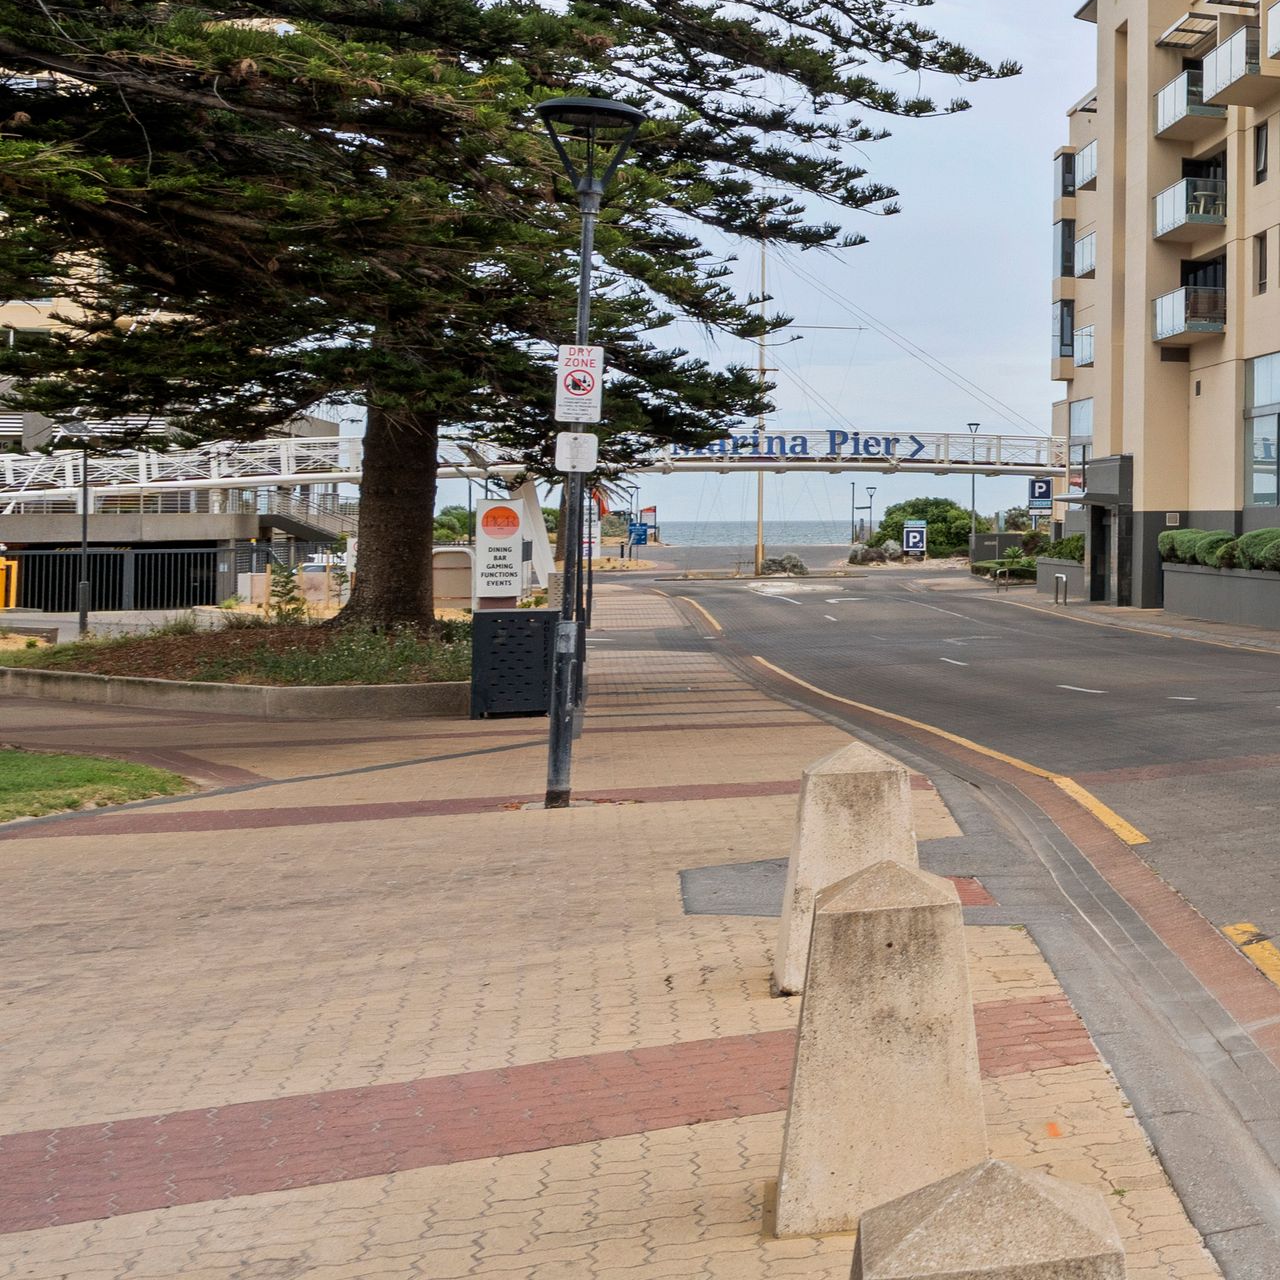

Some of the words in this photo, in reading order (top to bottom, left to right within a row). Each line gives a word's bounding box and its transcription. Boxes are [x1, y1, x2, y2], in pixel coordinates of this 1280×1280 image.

[569, 347, 593, 356] DRY
[564, 358, 596, 368] ZONE
[671, 429, 809, 456] arina
[826, 429, 900, 456] Pier
[1035, 482, 1046, 497] P
[909, 532, 920, 547] P
